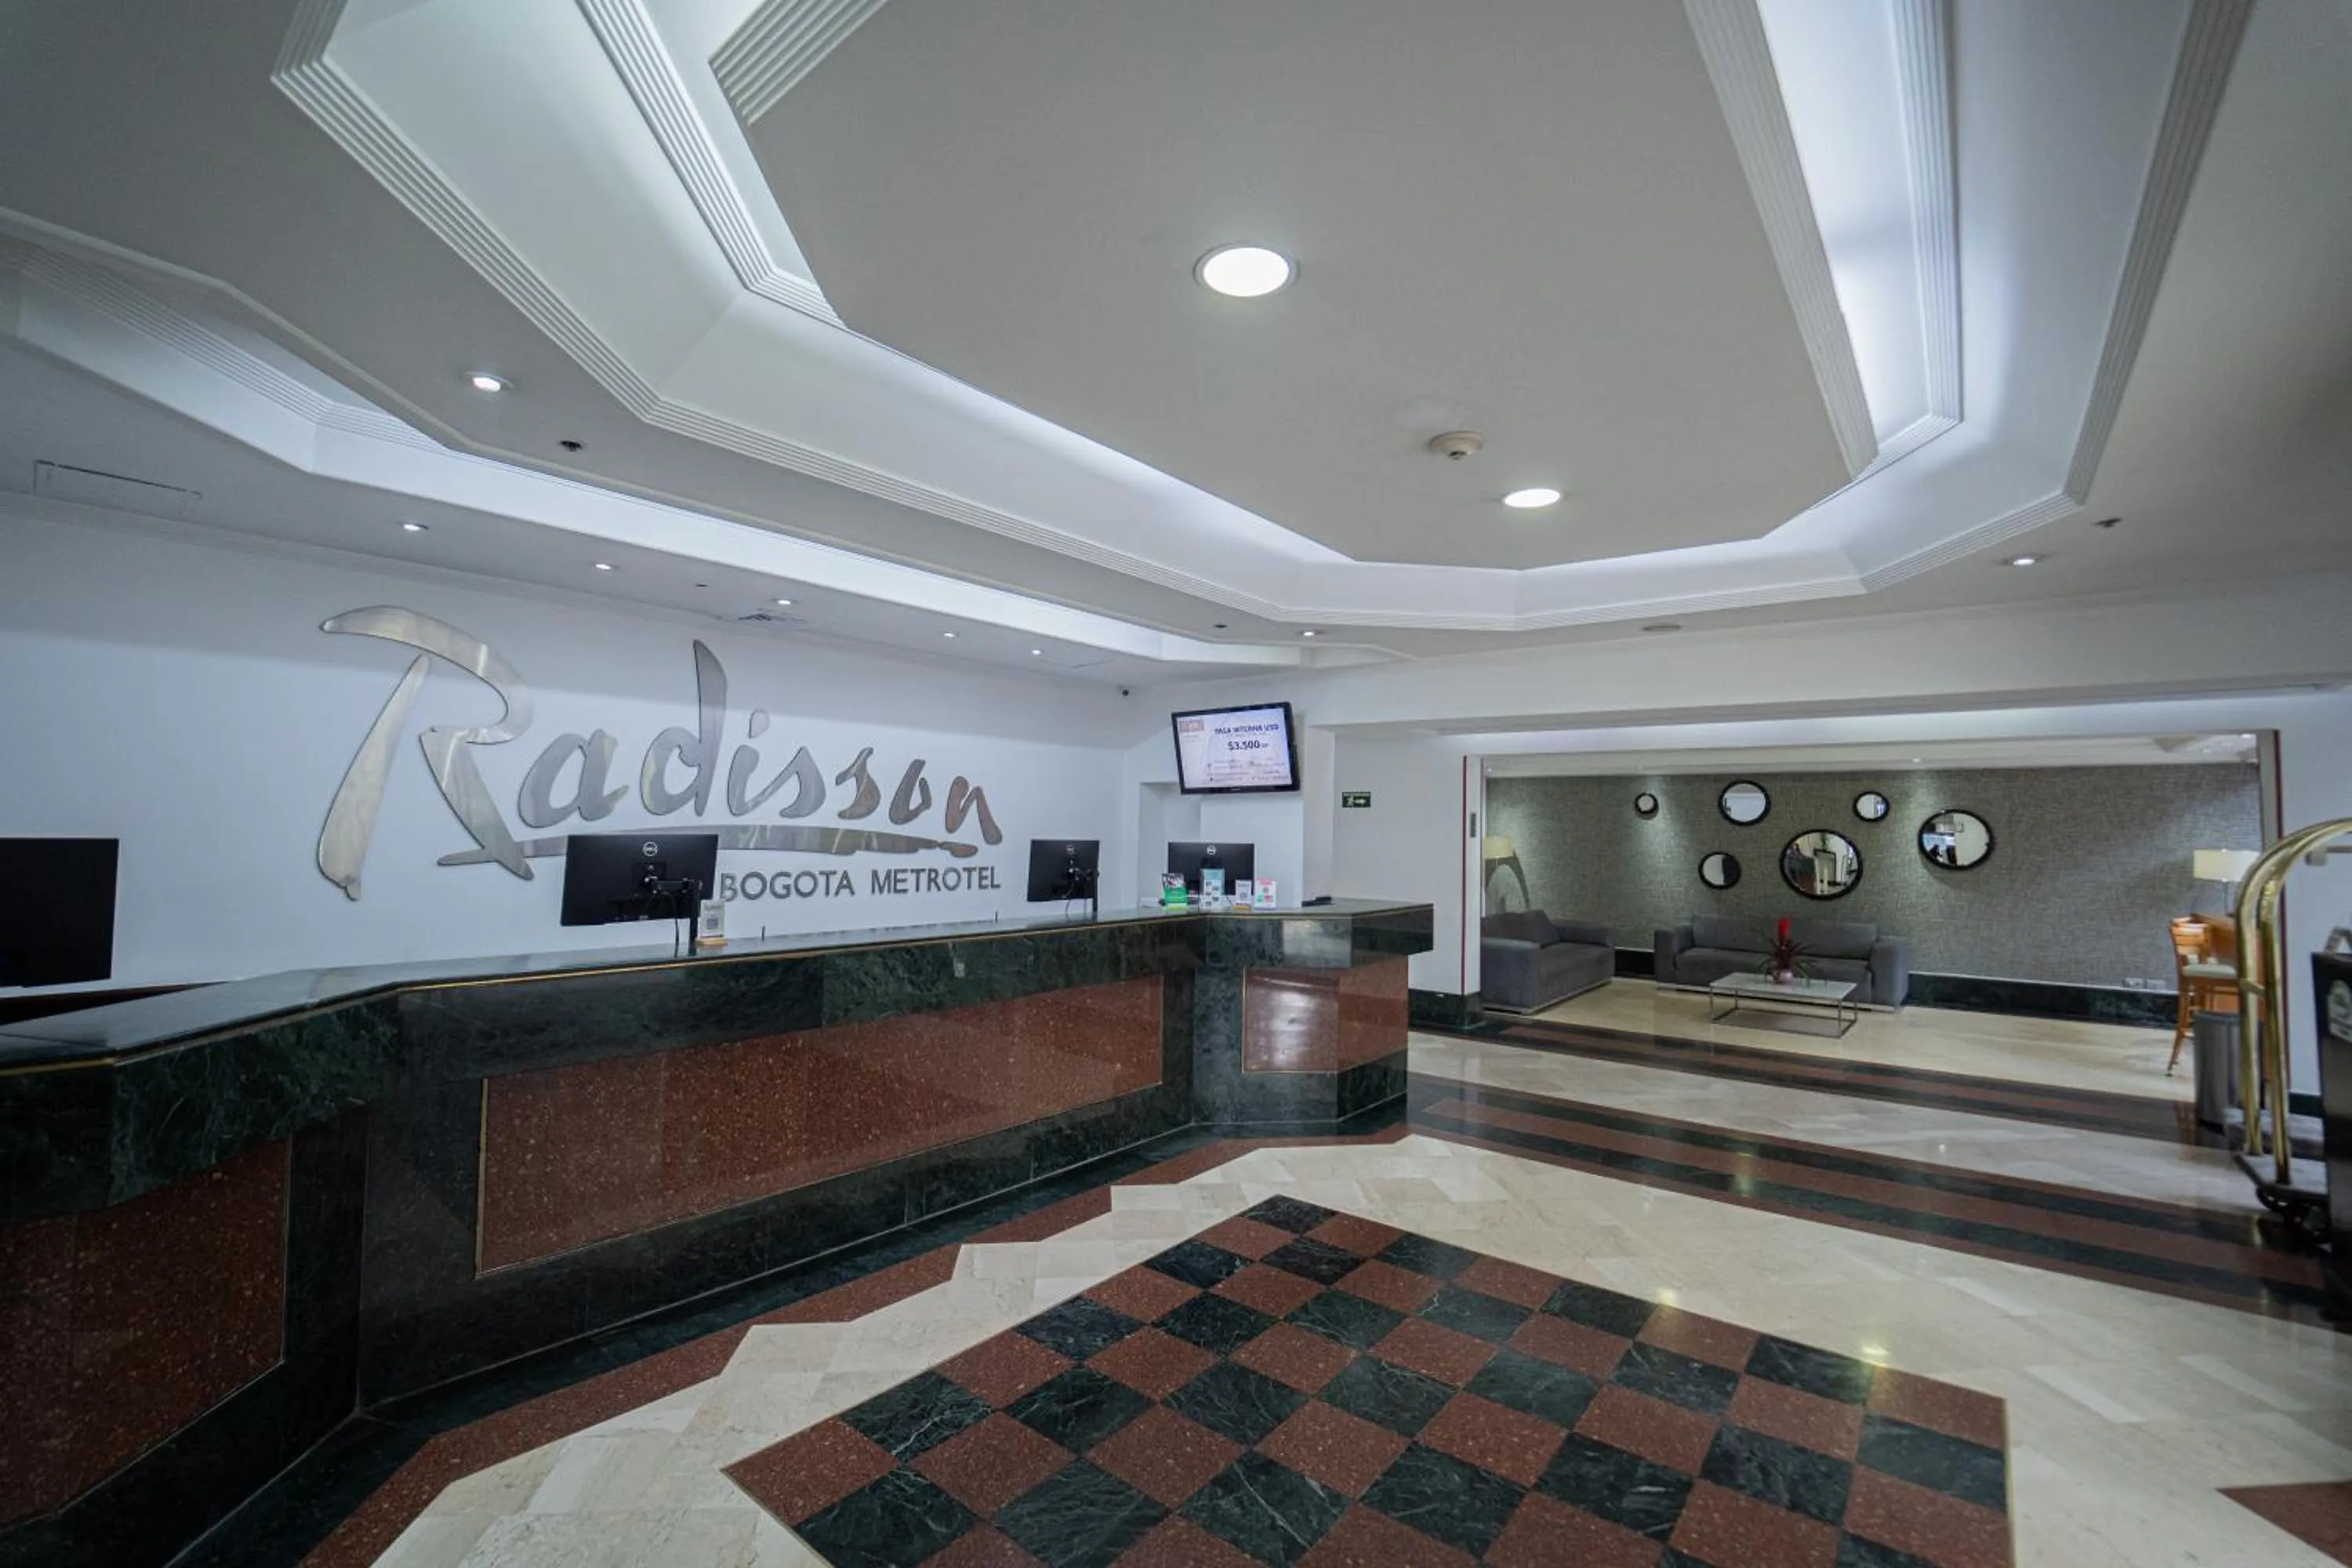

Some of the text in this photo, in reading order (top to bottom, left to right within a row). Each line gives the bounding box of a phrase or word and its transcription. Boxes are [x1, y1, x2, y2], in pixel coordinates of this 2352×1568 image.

[318, 605, 1003, 901] Radisson
[720, 866, 1001, 902] BOGOTA METROTEL
